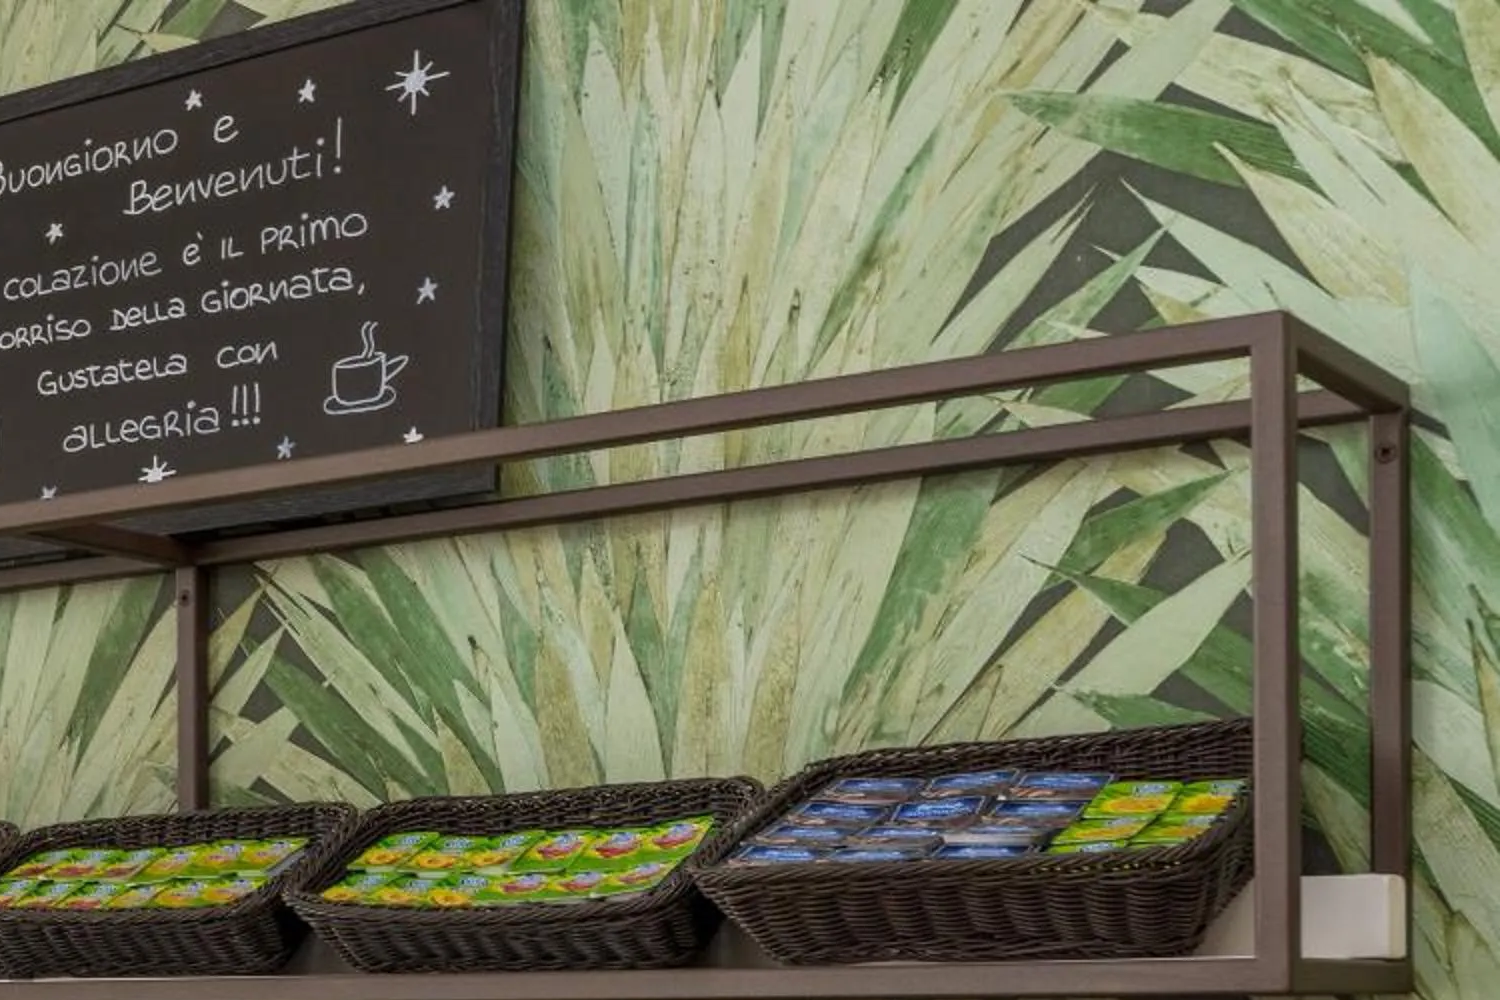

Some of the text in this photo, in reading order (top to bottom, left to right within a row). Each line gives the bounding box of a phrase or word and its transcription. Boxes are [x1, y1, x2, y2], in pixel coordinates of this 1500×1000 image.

[213, 115, 239, 143] e
[123, 116, 342, 215] Benvenuti!
[216, 341, 278, 369] con
